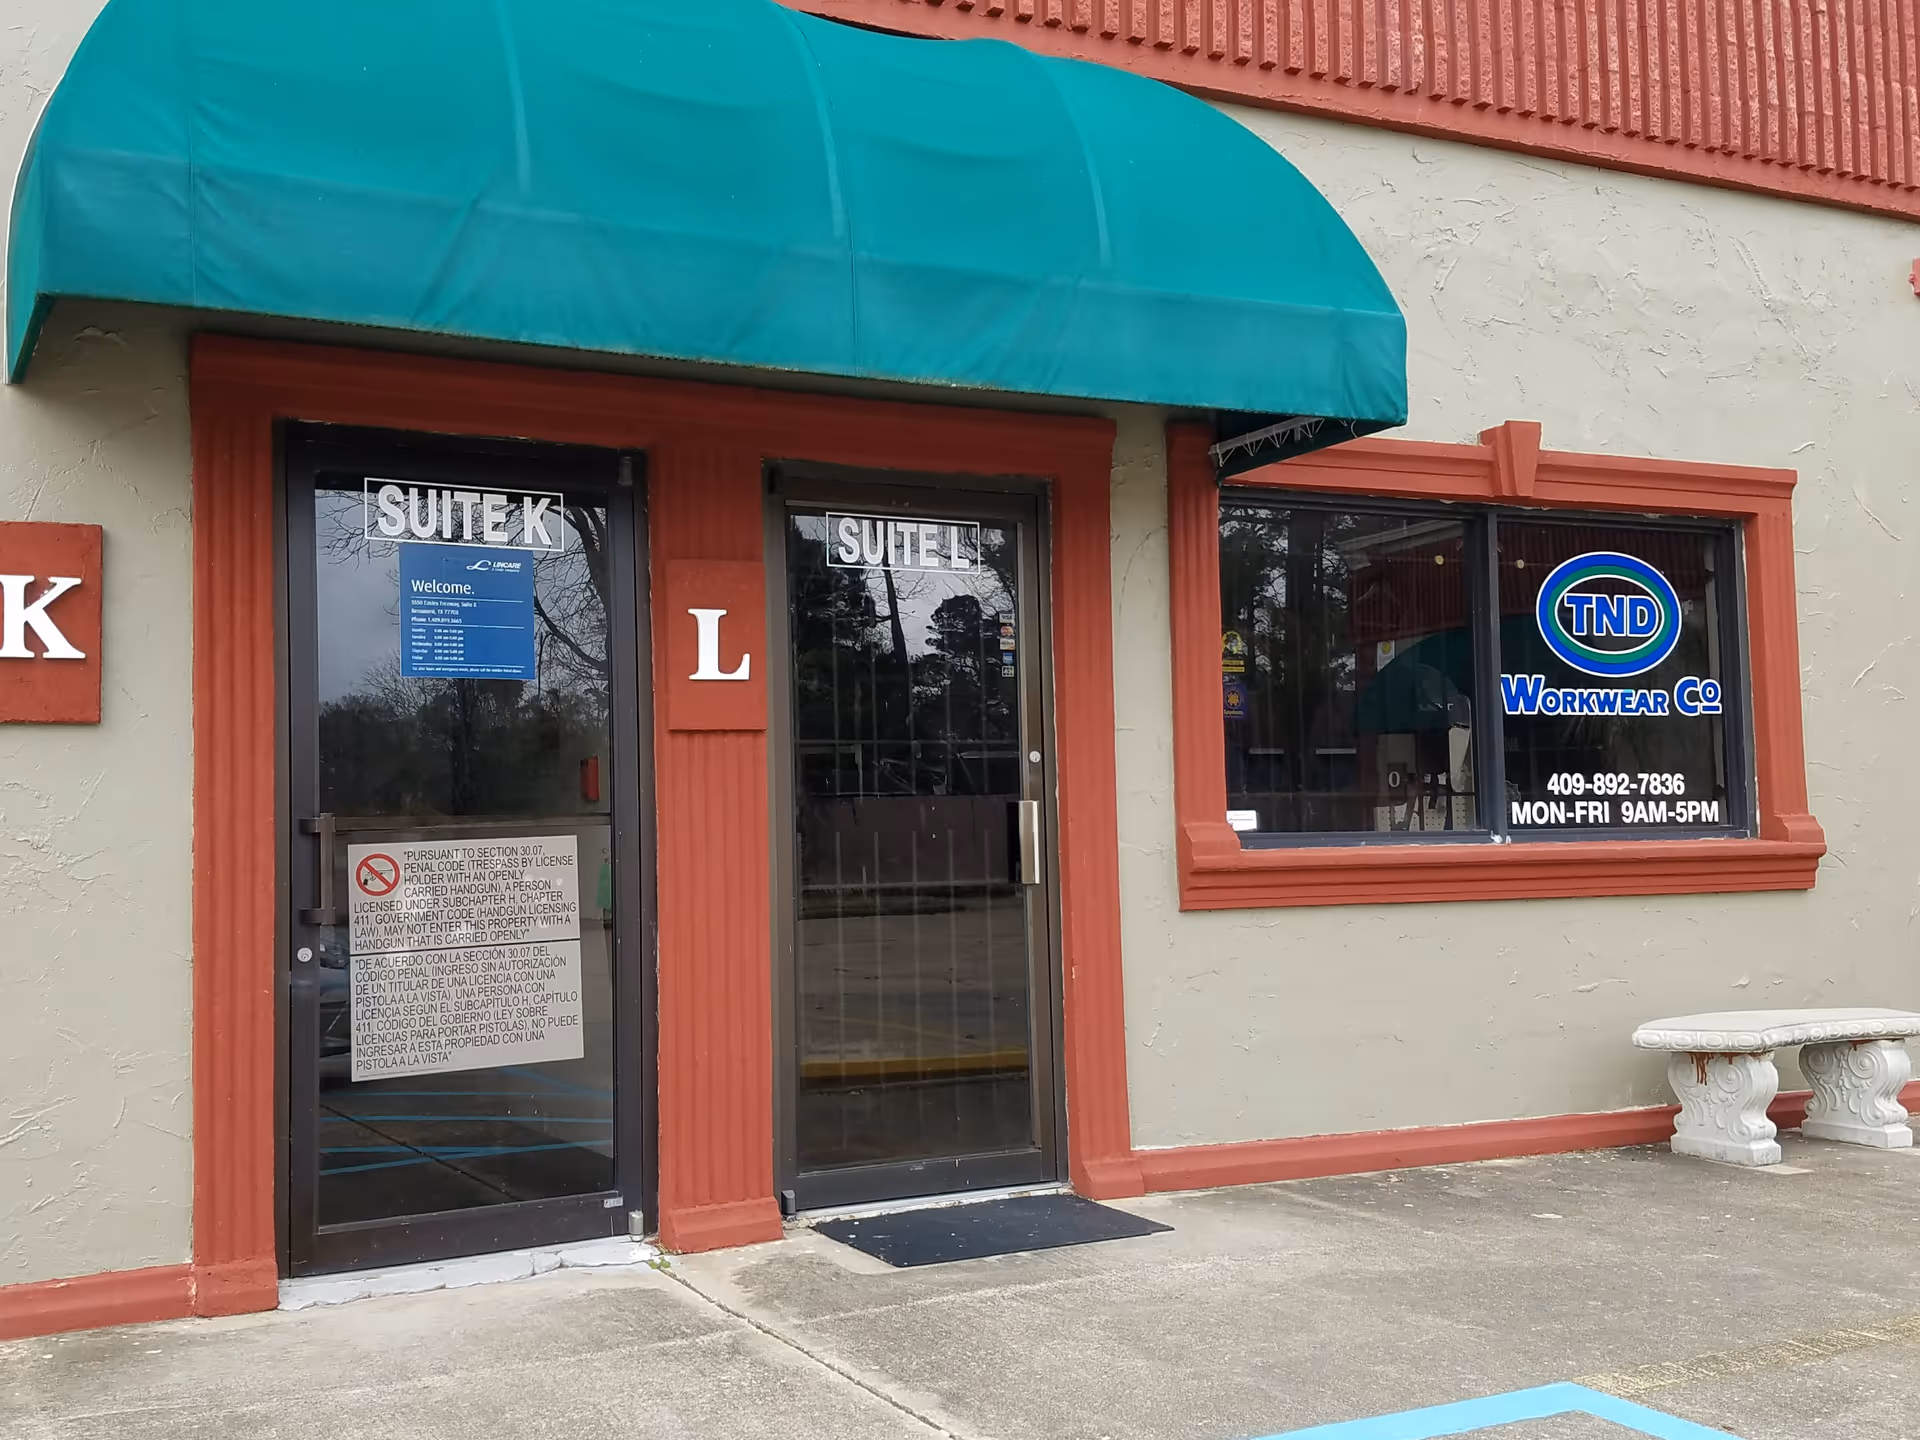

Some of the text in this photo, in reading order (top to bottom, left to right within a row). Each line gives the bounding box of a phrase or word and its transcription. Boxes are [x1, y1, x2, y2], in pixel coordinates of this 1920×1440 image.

[378, 485, 552, 545] SUITE K
[839, 517, 969, 568] SUITE L
[411, 579, 475, 594] Welcome.
[0, 574, 86, 658] K
[1565, 593, 1658, 636] TND
[688, 608, 750, 680] L
[1500, 674, 1669, 716] WORKWEAR
[1548, 772, 1685, 796] 409-892-7836
[1512, 800, 1719, 824] MON-FRI 9AM-5PM
[404, 849, 459, 860] "PURSUANT
[462, 848, 474, 858] TO
[478, 847, 518, 857] SECTION
[404, 855, 573, 873] PENAL CODE (TRESPASS BY LICENSE
[404, 870, 524, 885] HOLDER WITH AN OPENLY
[404, 885, 447, 898] CARRIED
[505, 882, 511, 892] A
[513, 880, 551, 891] PERSON
[354, 900, 402, 913] LICENSED
[406, 898, 440, 910] UNDER
[443, 894, 506, 908] SUBCHAPTER
[520, 891, 563, 903] CHAPTER
[376, 910, 444, 924] GOVERNMENT
[447, 908, 474, 920] CODE
[477, 905, 526, 918] (HANDGUN
[529, 902, 576, 914] LICENSING
[384, 925, 404, 936] MAY
[407, 923, 426, 935] NOT
[430, 921, 461, 933] ENTER
[465, 920, 485, 931] THIS
[488, 916, 538, 929] PROPERTY
[540, 915, 562, 925] WITH
[565, 914, 571, 924] A
[355, 937, 404, 951] HANDGUN
[407, 935, 431, 947] THAT
[434, 935, 442, 945] IS
[445, 932, 487, 944] CARRIED
[355, 946, 550, 970] "DE ACUERDO CON LA SECCIÓN 30.07 DEL
[356, 955, 566, 983] CÓDIGO PENAL (INGRESO SIN AUTORIZACIÓN
[356, 969, 556, 995] DE UN TITULAR DE UNA LICENCIA CON UNA
[356, 994, 397, 1008] PISTOLA
[398, 994, 405, 1004] A
[407, 993, 420, 1003] LA
[456, 988, 476, 1000] UNA
[478, 984, 523, 997] PERSONA
[525, 982, 544, 993] CON
[356, 1007, 401, 1020] LICENCIA
[403, 1002, 437, 1016] SEGÚN
[440, 1002, 451, 1013] EL
[454, 994, 520, 1012] SUBCAPÍTULO
[533, 991, 578, 1004] CAPÍTULO
[357, 1030, 407, 1046] LICENCIAS
[411, 1028, 436, 1040] PARA
[438, 1024, 476, 1038] PORTAR
[532, 1018, 545, 1029] NO
[548, 1015, 578, 1028] PUEDE
[377, 1017, 416, 1031] CÓDIGO
[419, 1016, 437, 1027] DEL
[440, 1010, 491, 1025] GOBIERNO
[494, 1008, 514, 1021] (LEY
[516, 1006, 548, 1018] SOBRE
[357, 1030, 545, 1058] INGRESAR A ESTA PROPIEDAD CON UNA
[357, 1057, 398, 1071] PISTOLA
[399, 1056, 406, 1066] A
[408, 1054, 419, 1066] LA
